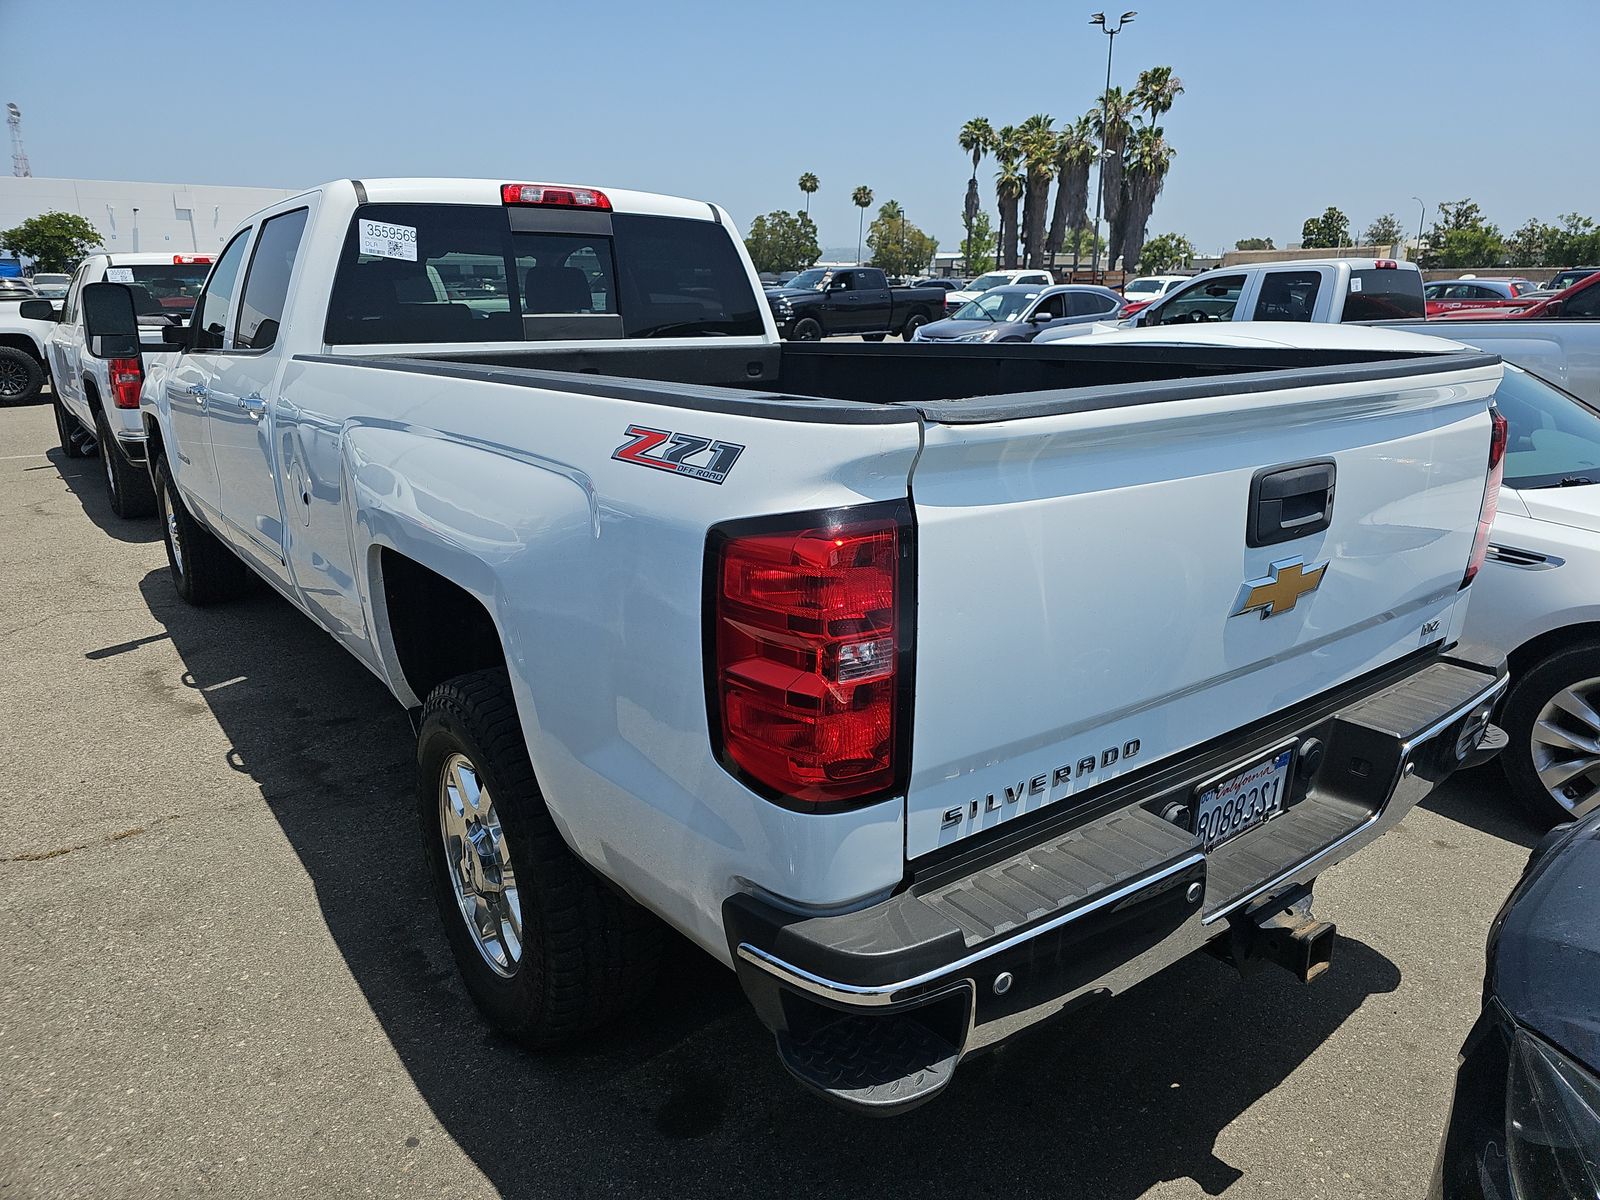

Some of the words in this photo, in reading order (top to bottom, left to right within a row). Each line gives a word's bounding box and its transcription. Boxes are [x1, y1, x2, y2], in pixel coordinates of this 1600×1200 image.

[367, 223, 417, 243] 3559569
[611, 424, 746, 480] Z71
[677, 465, 695, 475] OFF
[695, 469, 723, 482] ROAD
[941, 737, 1141, 830] SILVERADO
[1215, 766, 1275, 800] California
